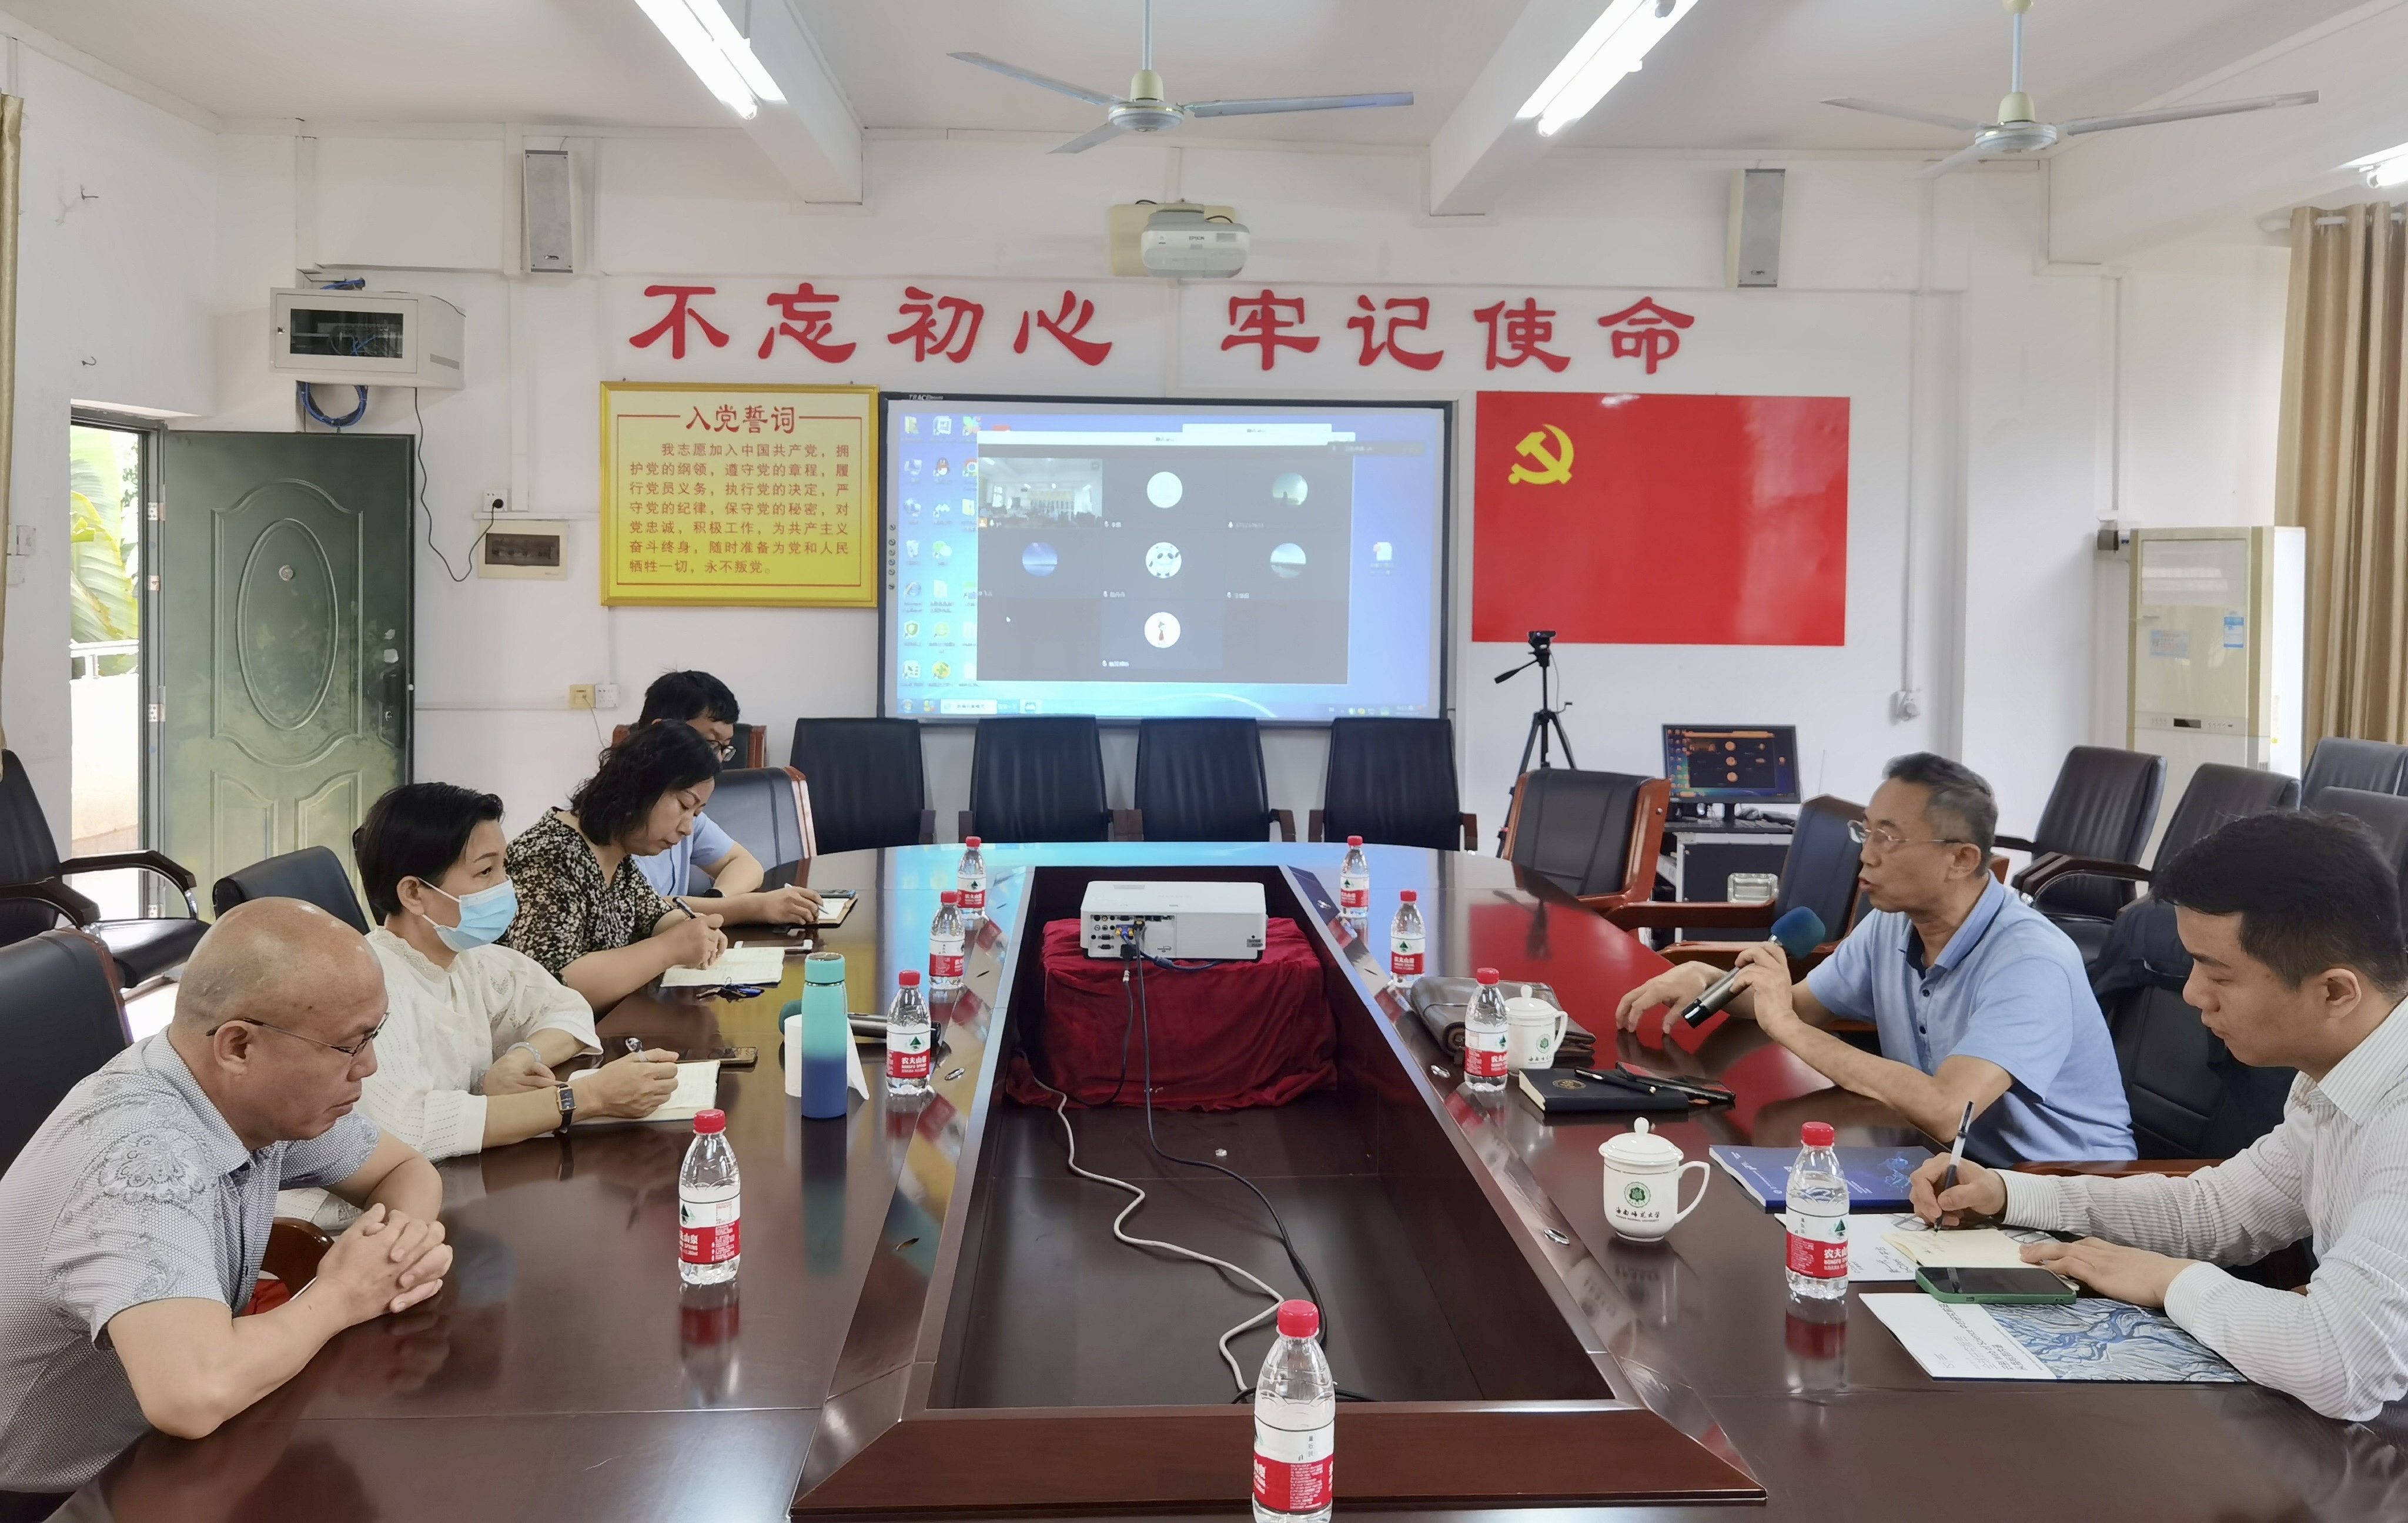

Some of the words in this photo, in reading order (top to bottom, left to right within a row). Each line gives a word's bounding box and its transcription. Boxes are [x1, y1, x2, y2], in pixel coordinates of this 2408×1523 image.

[630, 283, 1112, 366] 不忘初心
[1222, 290, 1694, 374] 牢记使命
[686, 404, 796, 434] 入党誓词
